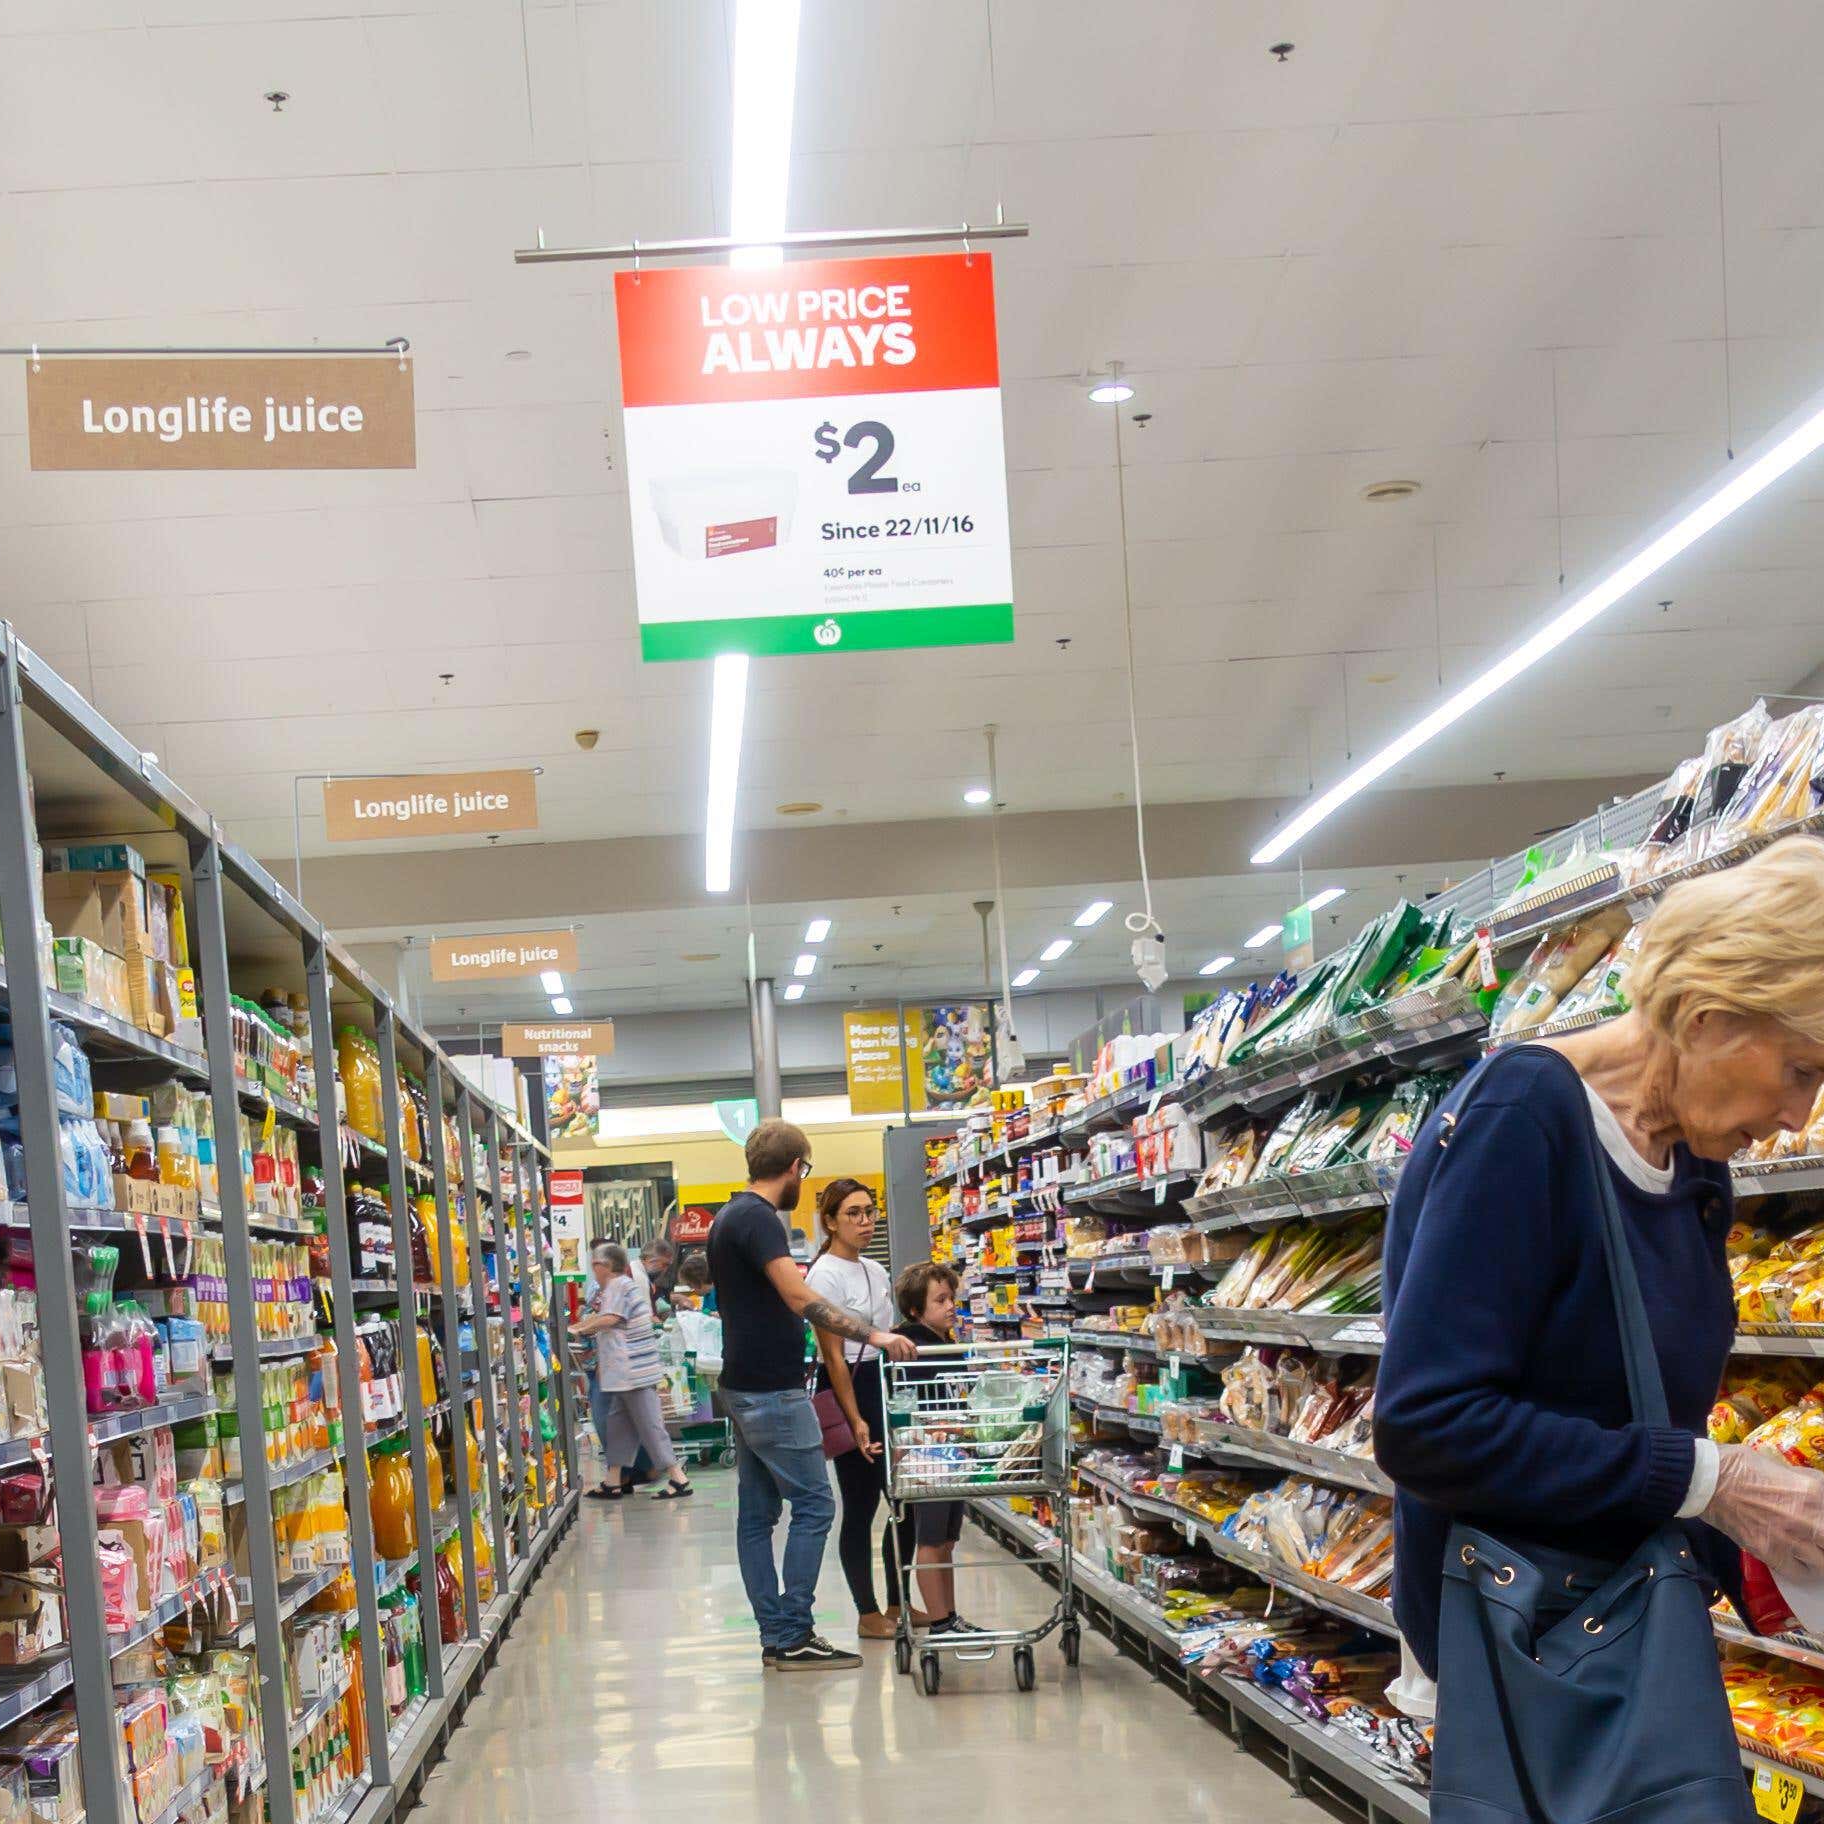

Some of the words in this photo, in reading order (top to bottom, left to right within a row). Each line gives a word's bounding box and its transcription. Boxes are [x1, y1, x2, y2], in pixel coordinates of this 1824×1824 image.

[701, 293, 790, 327] LOW
[799, 285, 911, 321] PRICE
[701, 322, 916, 374] ALWAYS
[82, 397, 251, 442] Longlife
[265, 397, 363, 442] juice
[814, 420, 898, 495] $2
[902, 481, 921, 493] ea
[821, 522, 879, 540] Since
[886, 515, 974, 537] 22/11/16
[848, 567, 865, 579] per
[868, 567, 882, 576] ea
[354, 795, 448, 820] Longlife
[453, 791, 509, 816] juice
[451, 949, 517, 967] Longlife
[519, 947, 558, 965] juice
[524, 1028, 592, 1040] Nutritional
[849, 1025, 880, 1035] More
[538, 1041, 579, 1053] snacks
[733, 1108, 745, 1127] 1
